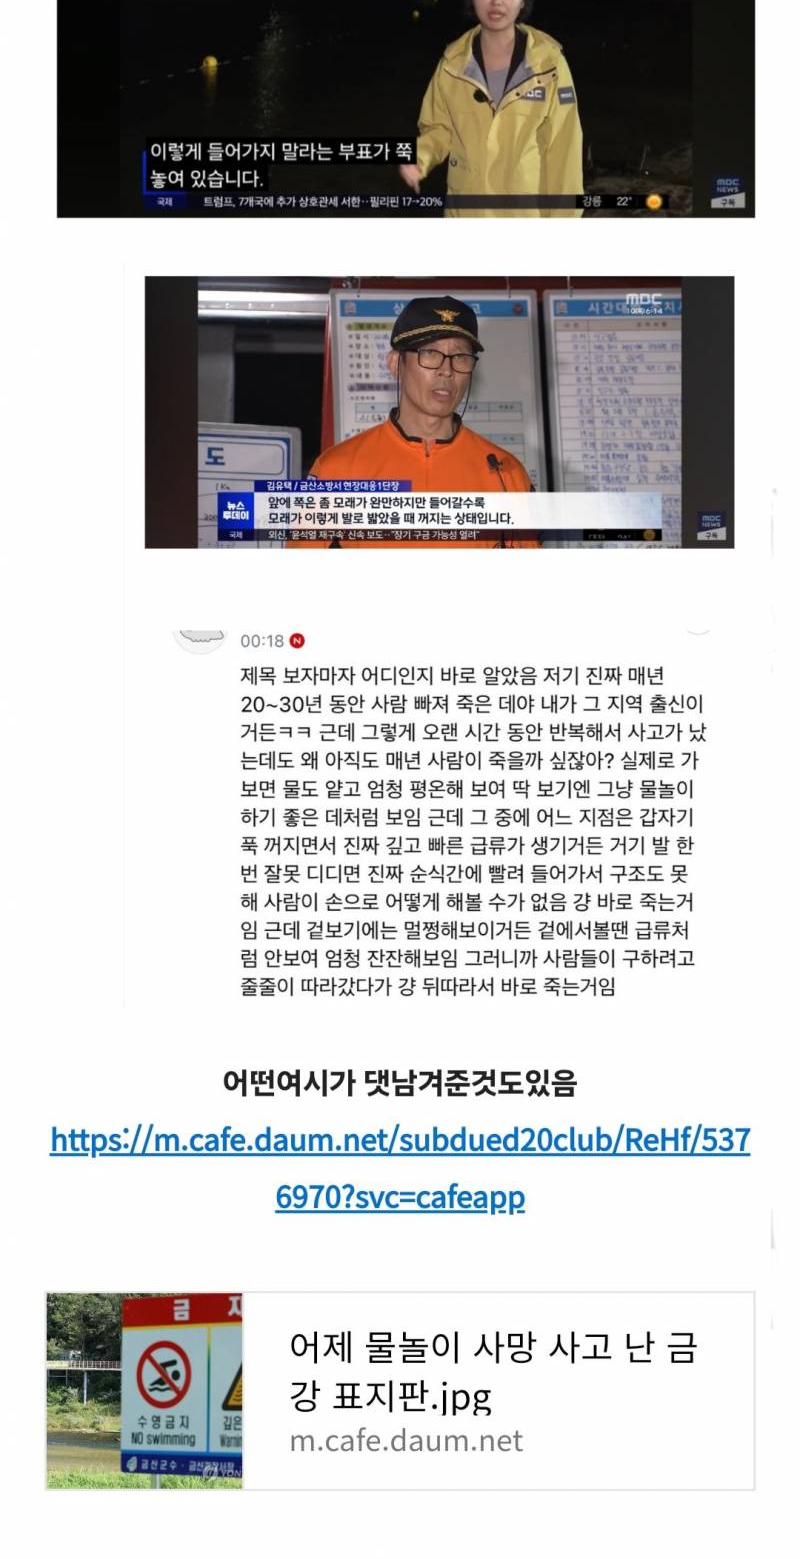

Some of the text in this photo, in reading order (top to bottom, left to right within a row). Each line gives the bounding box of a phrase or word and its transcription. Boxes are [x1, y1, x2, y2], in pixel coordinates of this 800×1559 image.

[205, 446, 226, 465] 도
[239, 665, 664, 687] 제목 보자마자 어디인지 바로 알았음 저기 진짜 매년
[223, 1068, 578, 1098] 어떤여시가 댓남겨준것도있음
[48, 1122, 752, 1159] https://m.cafe.daum.net/subdued20club/ReHf/537
[290, 1330, 698, 1365] 어제 물놀이 사망 사고 난 금
[289, 1379, 492, 1417] 강 표지판.jpg
[138, 1415, 190, 1430] 수영금지
[131, 1432, 196, 1447] NO swimming
[290, 1426, 524, 1453] m.cafe.daum.net
